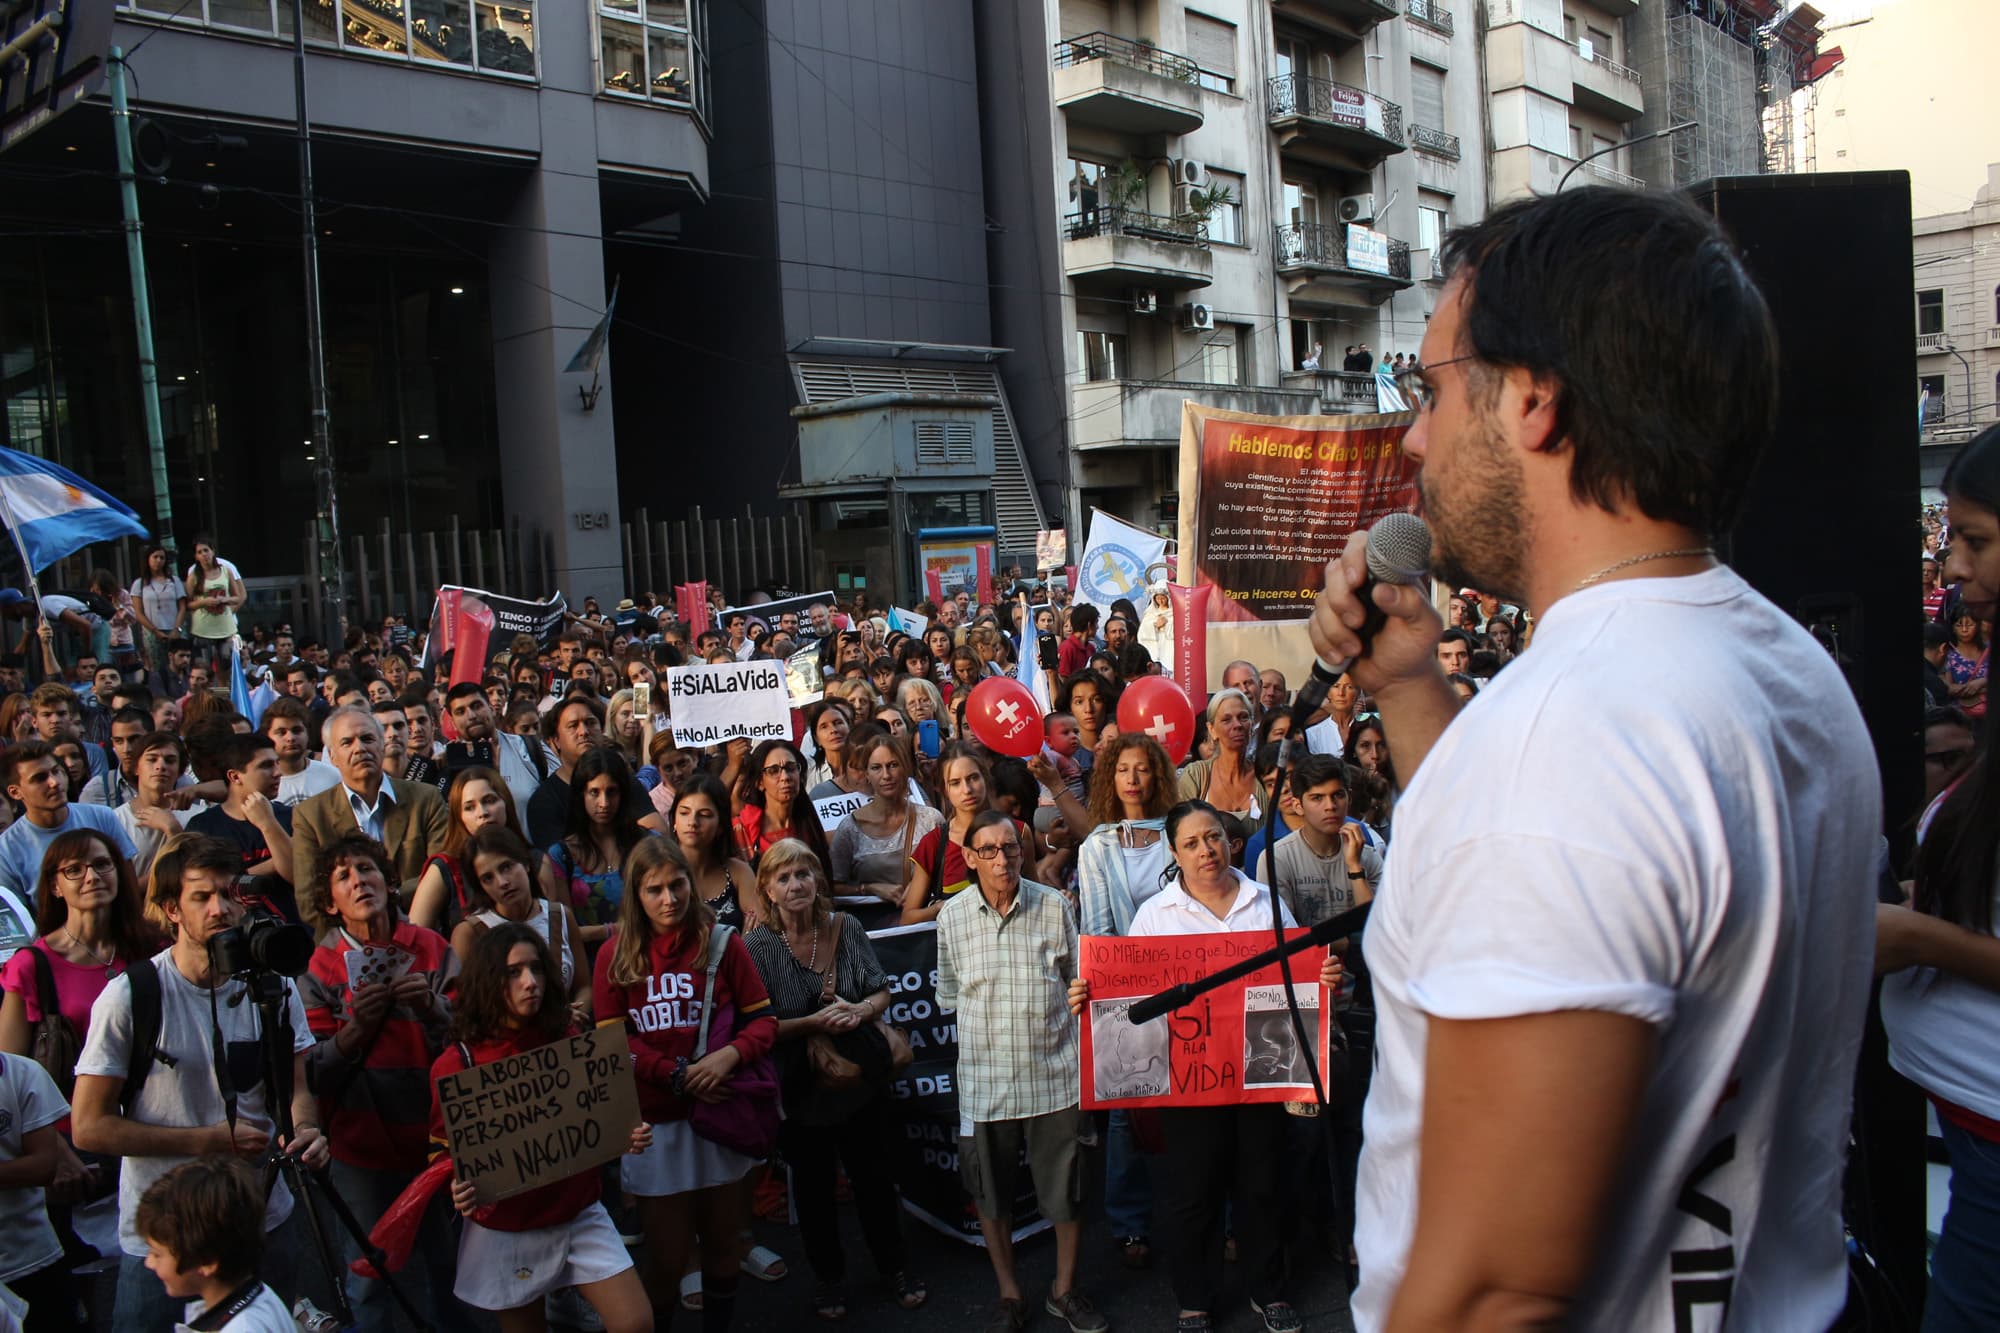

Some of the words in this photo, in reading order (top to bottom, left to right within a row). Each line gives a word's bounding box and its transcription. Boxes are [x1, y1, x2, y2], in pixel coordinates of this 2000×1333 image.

[1228, 433, 1313, 460] Hablemos
[1318, 441, 1358, 461] Claro
[1363, 442, 1376, 459] de
[1380, 440, 1393, 458] la
[1310, 467, 1329, 476] niño
[1224, 481, 1244, 490] cuya
[1245, 482, 1286, 493] existencia
[1218, 503, 1230, 511] No
[1230, 503, 1245, 513] hay
[1246, 504, 1264, 513] acto
[1265, 505, 1276, 514] de
[1277, 507, 1301, 516] mayor
[1263, 514, 1279, 522] que
[1280, 515, 1306, 523] decidir
[1330, 518, 1350, 526] nace
[1350, 519, 1356, 527] y
[1230, 527, 1251, 536] culpa
[1252, 528, 1277, 537] tienen
[1278, 530, 1290, 538] los
[1291, 530, 1312, 538] niños
[1207, 552, 1228, 560] social
[1235, 552, 1274, 561] económica
[1275, 553, 1293, 561] para
[1294, 553, 1302, 561] la
[1208, 543, 1248, 552] Apostemos
[1256, 543, 1263, 551] la
[1264, 543, 1281, 552] vida
[1282, 545, 1287, 553] y
[1288, 545, 1322, 554] pidamos
[1223, 589, 1249, 600] Para
[1251, 588, 1297, 600] Hacerse
[499, 610, 532, 623] TENGO
[499, 621, 532, 633] TENGO
[671, 668, 779, 697] #SiALaVida
[675, 721, 785, 743] #NoALaMuerte
[1003, 715, 1034, 740] VIDA
[1089, 942, 1110, 964] NO
[1113, 943, 1170, 964] MATEMOS
[646, 972, 694, 1002] LOS
[1089, 968, 1160, 989] DIGAMOS
[1247, 990, 1268, 1000] DIGO
[1268, 988, 1281, 1004] NO
[438, 1077, 473, 1102] EL
[479, 1047, 560, 1090] ABORTO
[569, 1032, 597, 1060] ES
[446, 1069, 571, 1126] DEFENDIDO
[584, 1053, 625, 1086] POR
[915, 1074, 952, 1097] DE
[452, 1096, 564, 1153] PERSONAS
[576, 1082, 611, 1112] QUE
[512, 1118, 601, 1185] NACIDO
